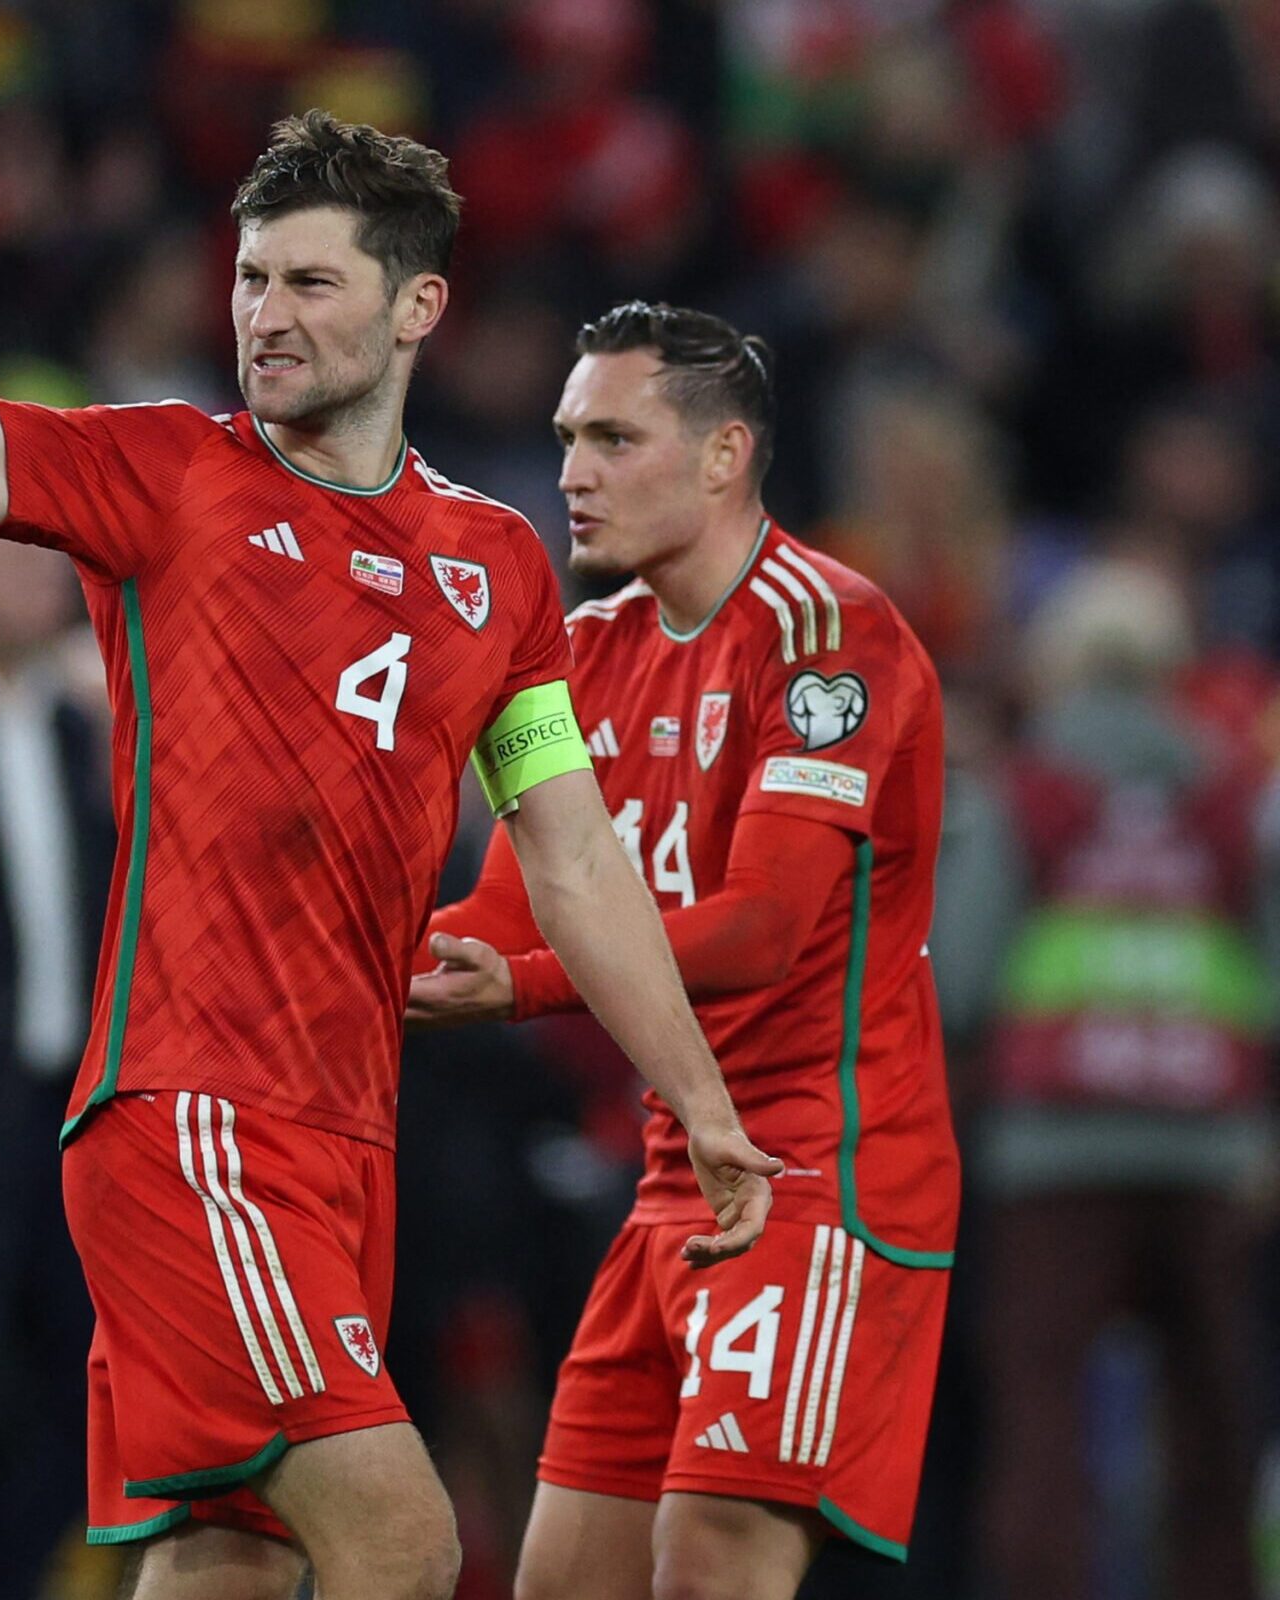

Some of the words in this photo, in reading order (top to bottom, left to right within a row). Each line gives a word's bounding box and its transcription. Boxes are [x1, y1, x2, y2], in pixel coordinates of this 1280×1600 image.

[335, 632, 412, 752] 4
[497, 719, 568, 760] RESPECT
[680, 1285, 784, 1400] 14
